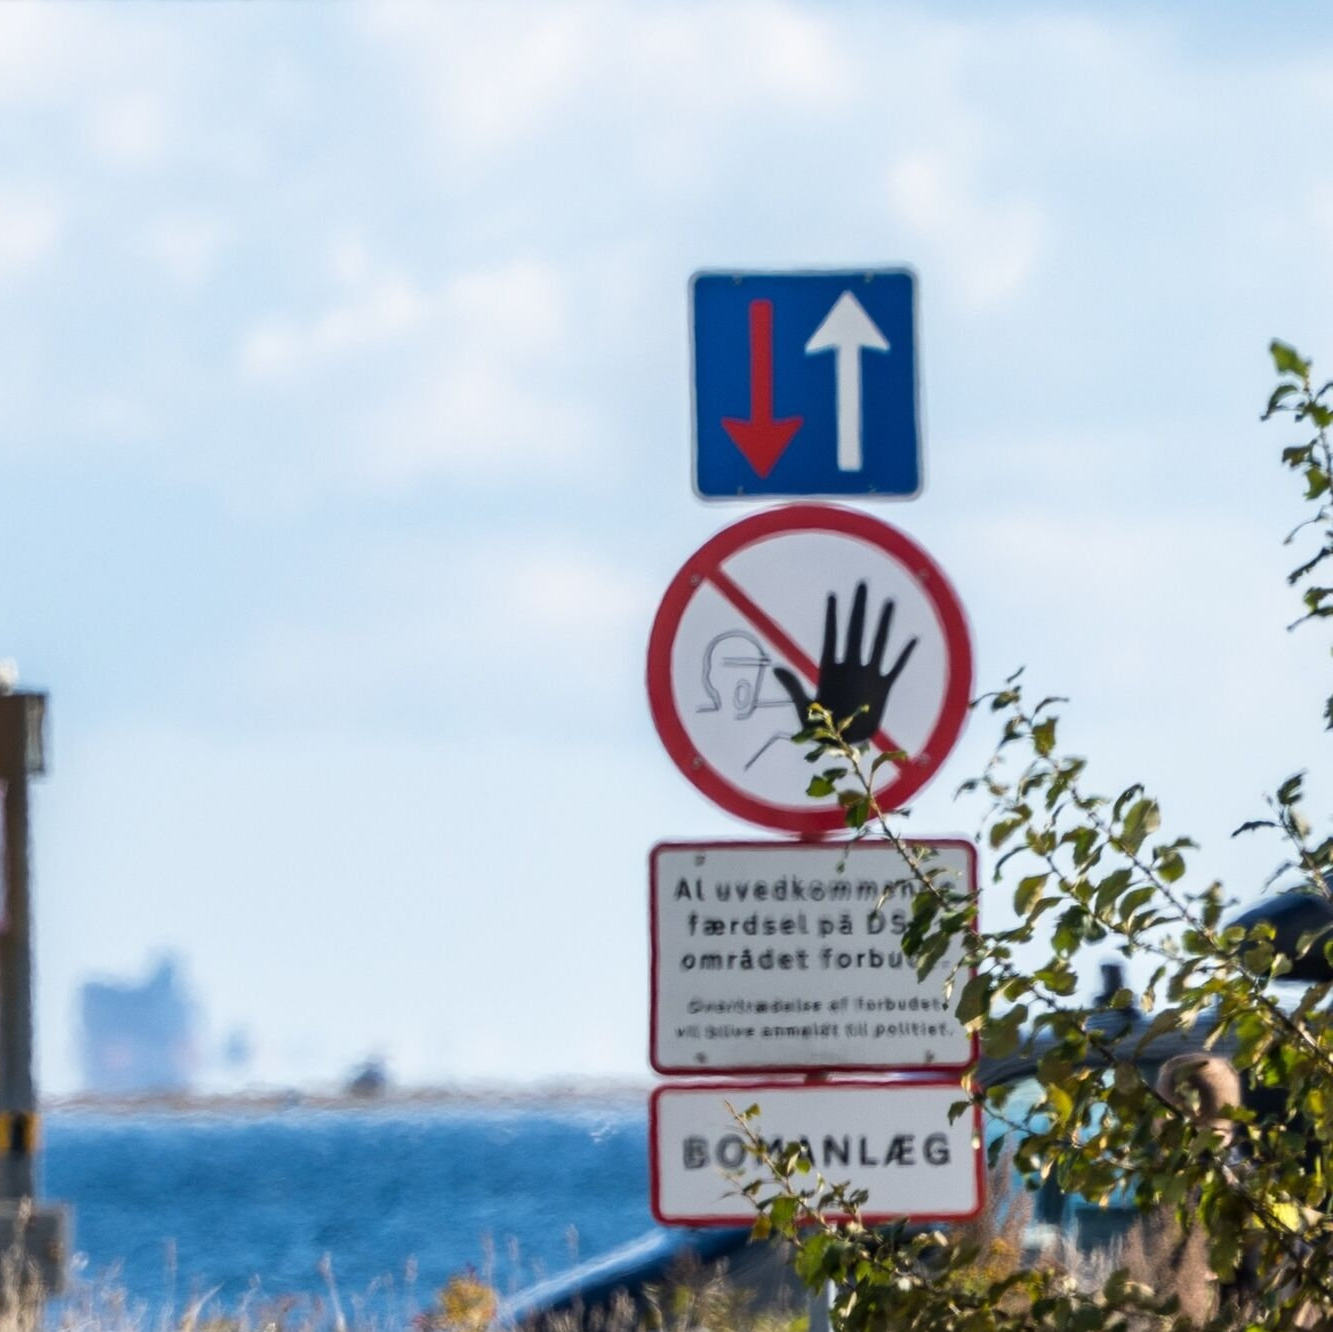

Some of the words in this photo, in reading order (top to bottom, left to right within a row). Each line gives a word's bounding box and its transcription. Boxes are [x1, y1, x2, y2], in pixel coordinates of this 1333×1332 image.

[674, 876, 705, 901] Al
[715, 874, 955, 902] uvedkommen
[688, 911, 808, 936] færdsel
[817, 912, 853, 938] på
[681, 946, 809, 971] området
